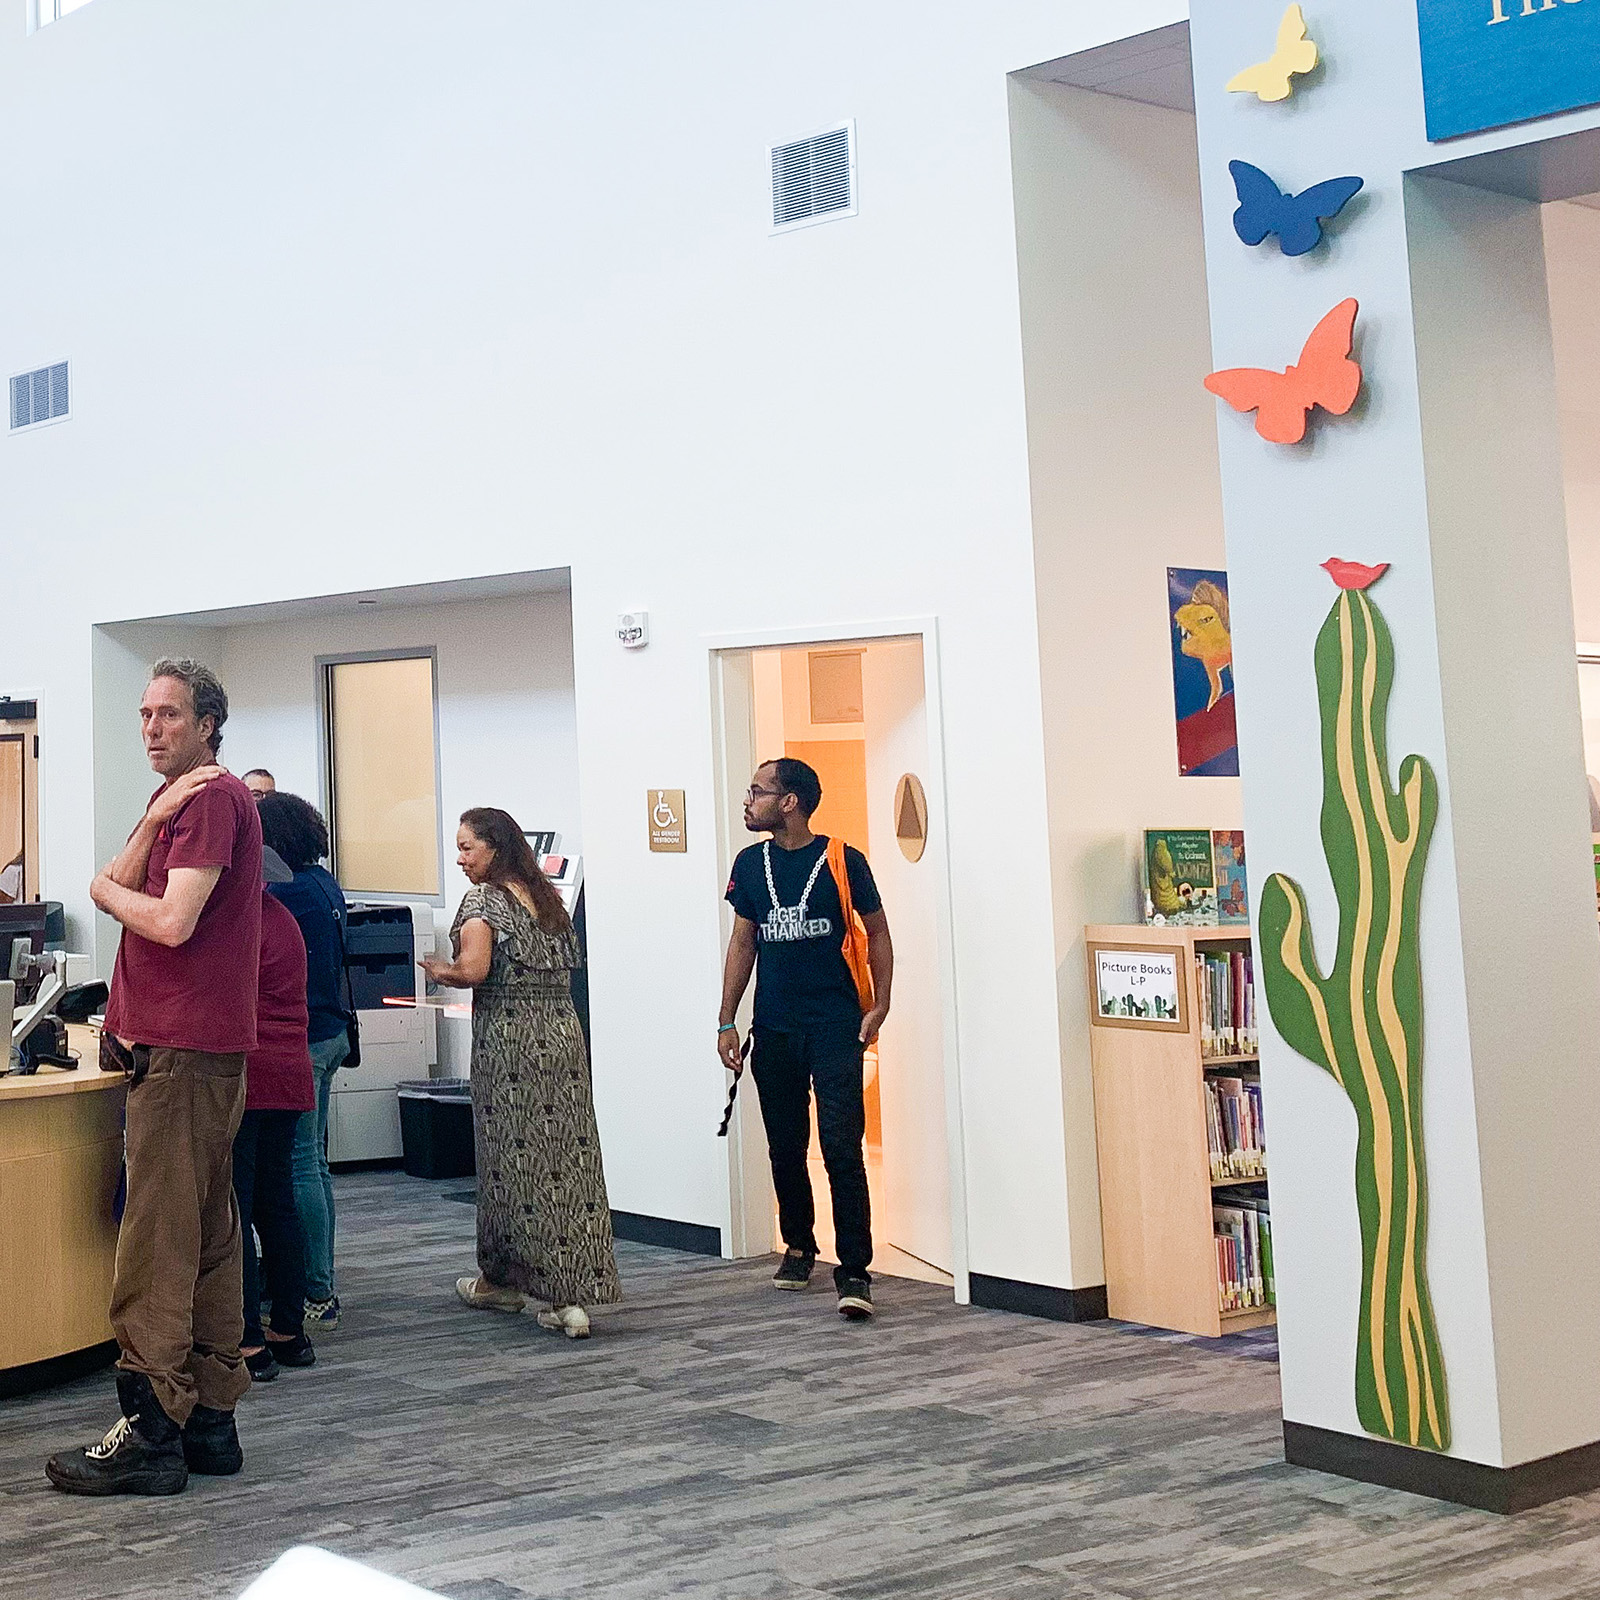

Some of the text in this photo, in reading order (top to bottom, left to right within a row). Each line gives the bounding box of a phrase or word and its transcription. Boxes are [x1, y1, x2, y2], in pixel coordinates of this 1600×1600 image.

[767, 905, 809, 924] #GET
[760, 918, 833, 942] THANKED
[1102, 961, 1172, 975] Picture Books
[1131, 976, 1146, 986] L-P
